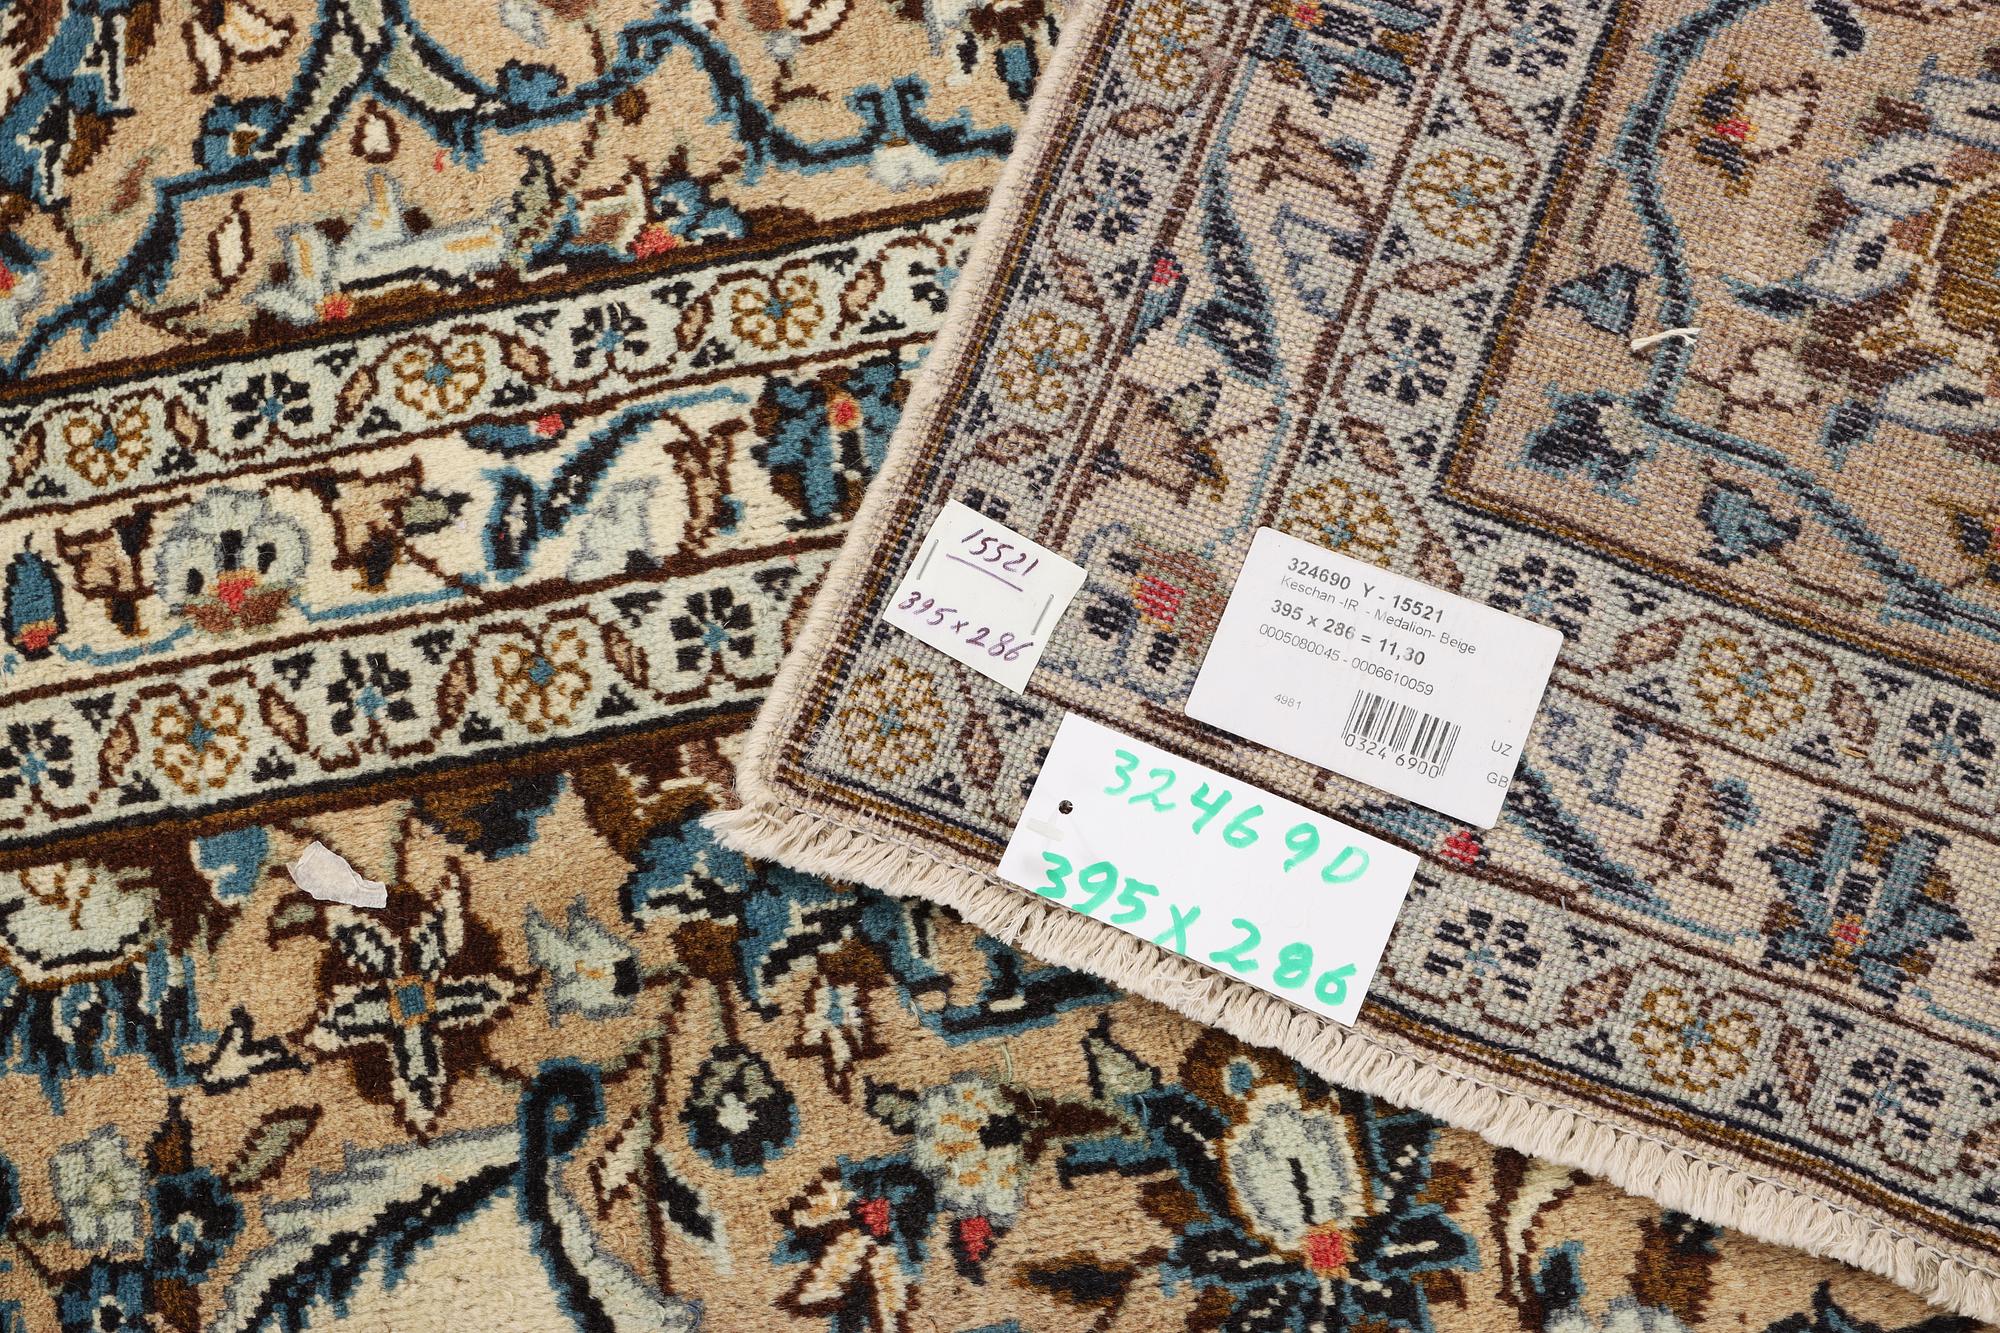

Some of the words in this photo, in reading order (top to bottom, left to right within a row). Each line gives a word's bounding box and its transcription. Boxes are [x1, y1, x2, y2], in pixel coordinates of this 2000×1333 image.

[961, 528, 1039, 576] 15521
[1288, 557, 1351, 590] 324690
[1363, 582, 1376, 598] Y
[1393, 594, 1444, 623] 15521
[1271, 599, 1304, 621] 395
[1307, 615, 1318, 627] x
[1323, 618, 1356, 640] 286
[1360, 634, 1371, 644] =
[1379, 638, 1426, 665] 11,30
[1281, 575, 1336, 603] Keschan
[1439, 632, 1477, 654] Beige
[1259, 623, 1341, 661] 0005080045
[1351, 657, 1434, 696] 0006610059
[1274, 693, 1302, 711] 4981
[1344, 733, 1387, 760] 0324
[1395, 753, 1440, 779] 6900
[1491, 739, 1513, 757] UZ
[1486, 771, 1509, 788] GB
